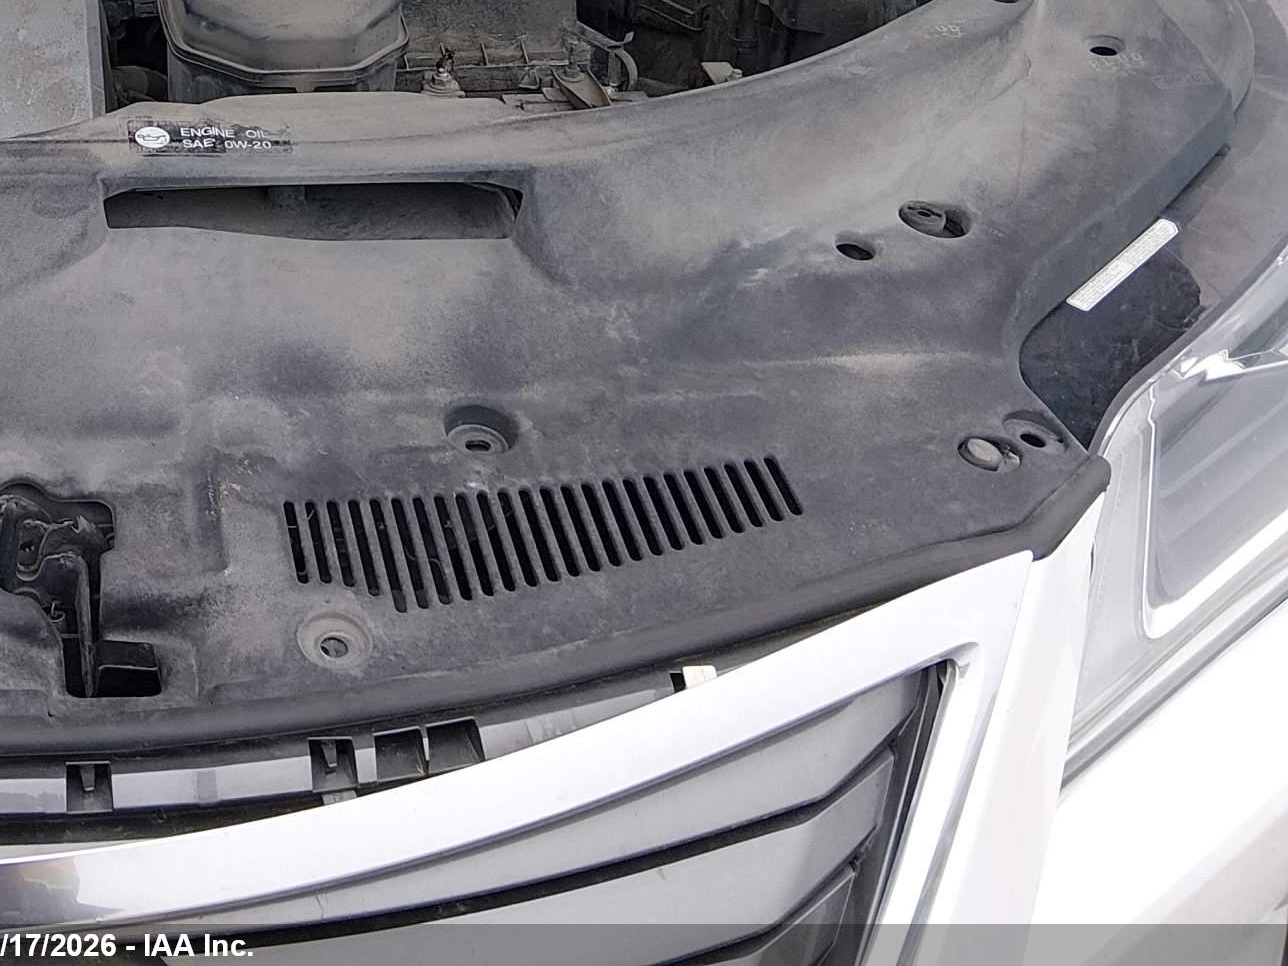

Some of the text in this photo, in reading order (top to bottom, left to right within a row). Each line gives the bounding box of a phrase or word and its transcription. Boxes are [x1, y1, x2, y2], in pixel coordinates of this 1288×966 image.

[180, 127, 266, 138] ENGINE OIL
[182, 138, 272, 149] SAE 0W-20
